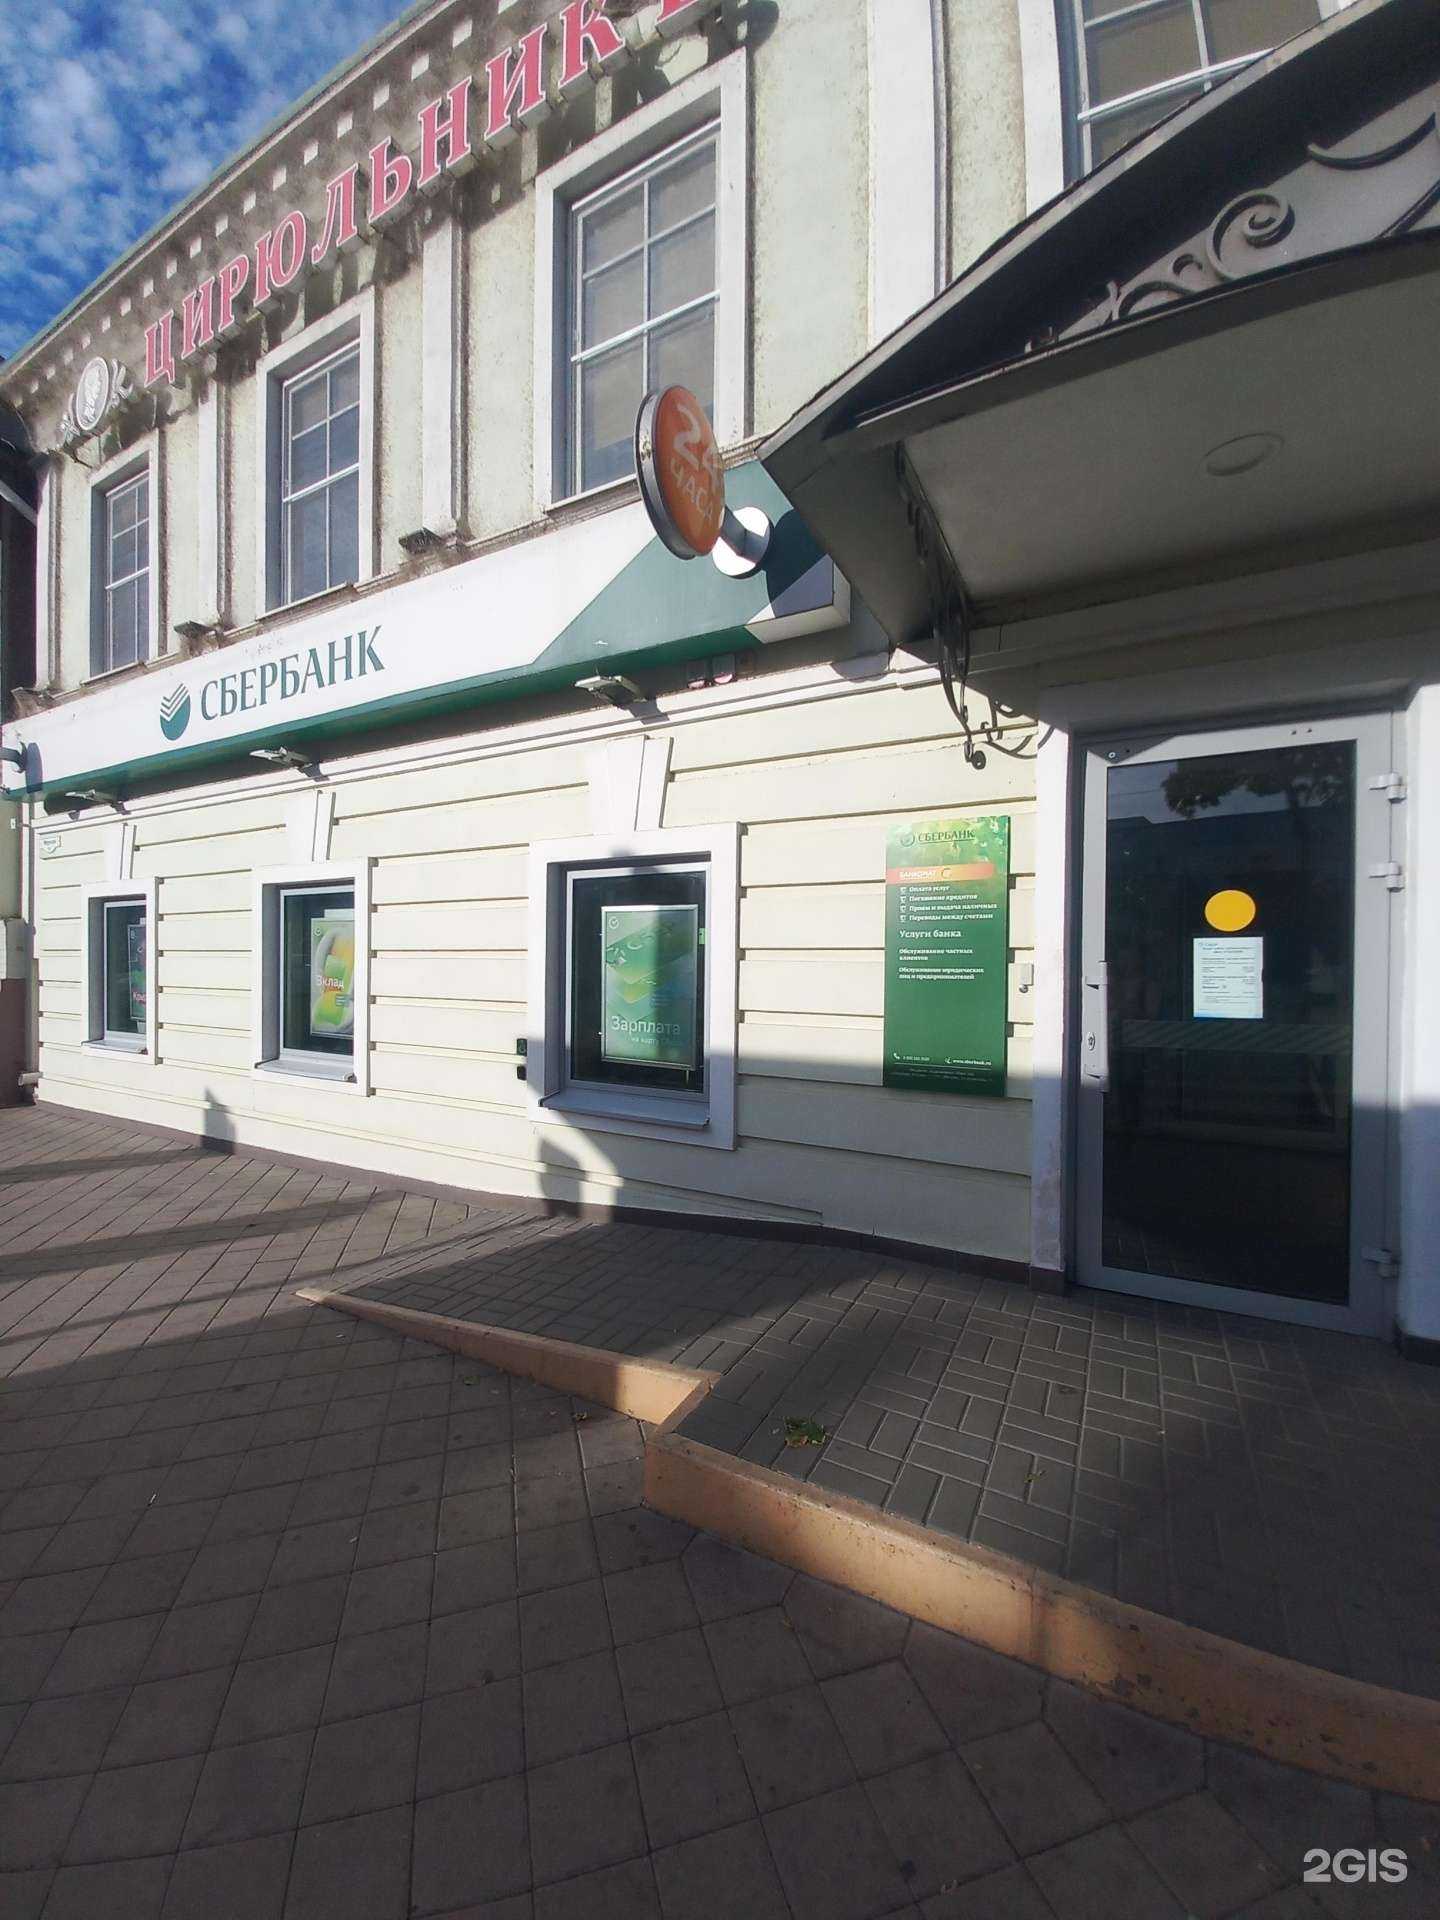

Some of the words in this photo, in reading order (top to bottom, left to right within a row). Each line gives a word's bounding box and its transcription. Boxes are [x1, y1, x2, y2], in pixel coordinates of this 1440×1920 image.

[143, 0, 700, 387] ЦИРЮЛЬНИК
[200, 624, 386, 721] СБЕРБАНК
[918, 829, 976, 841] СБЕРБАНК
[899, 930, 931, 939] Услуги
[933, 929, 962, 938] банка
[611, 1015, 681, 1035] Зарплата
